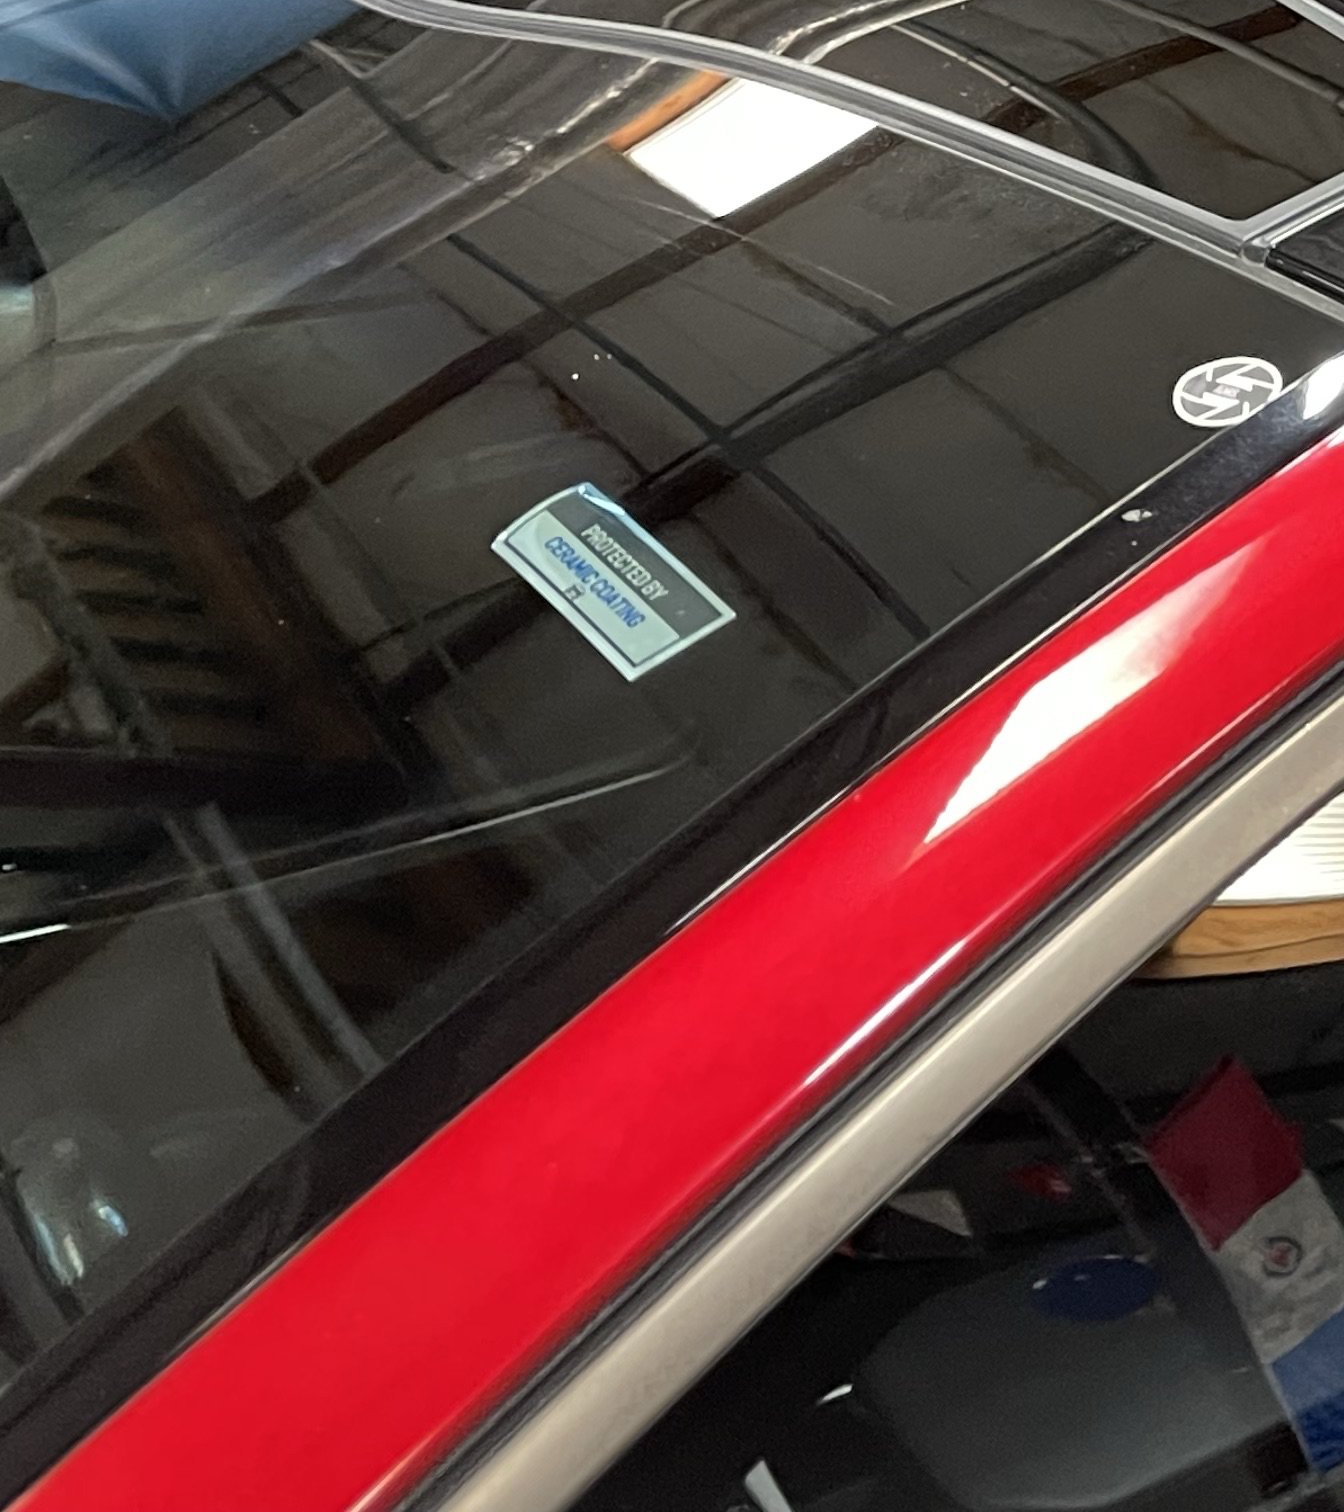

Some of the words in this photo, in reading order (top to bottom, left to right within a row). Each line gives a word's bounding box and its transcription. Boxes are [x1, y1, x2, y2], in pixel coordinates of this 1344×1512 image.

[544, 536, 599, 584] CERAMIC
[589, 578, 646, 628] COATING
[580, 523, 652, 587] PROTECTED
[640, 579, 669, 601] BY
